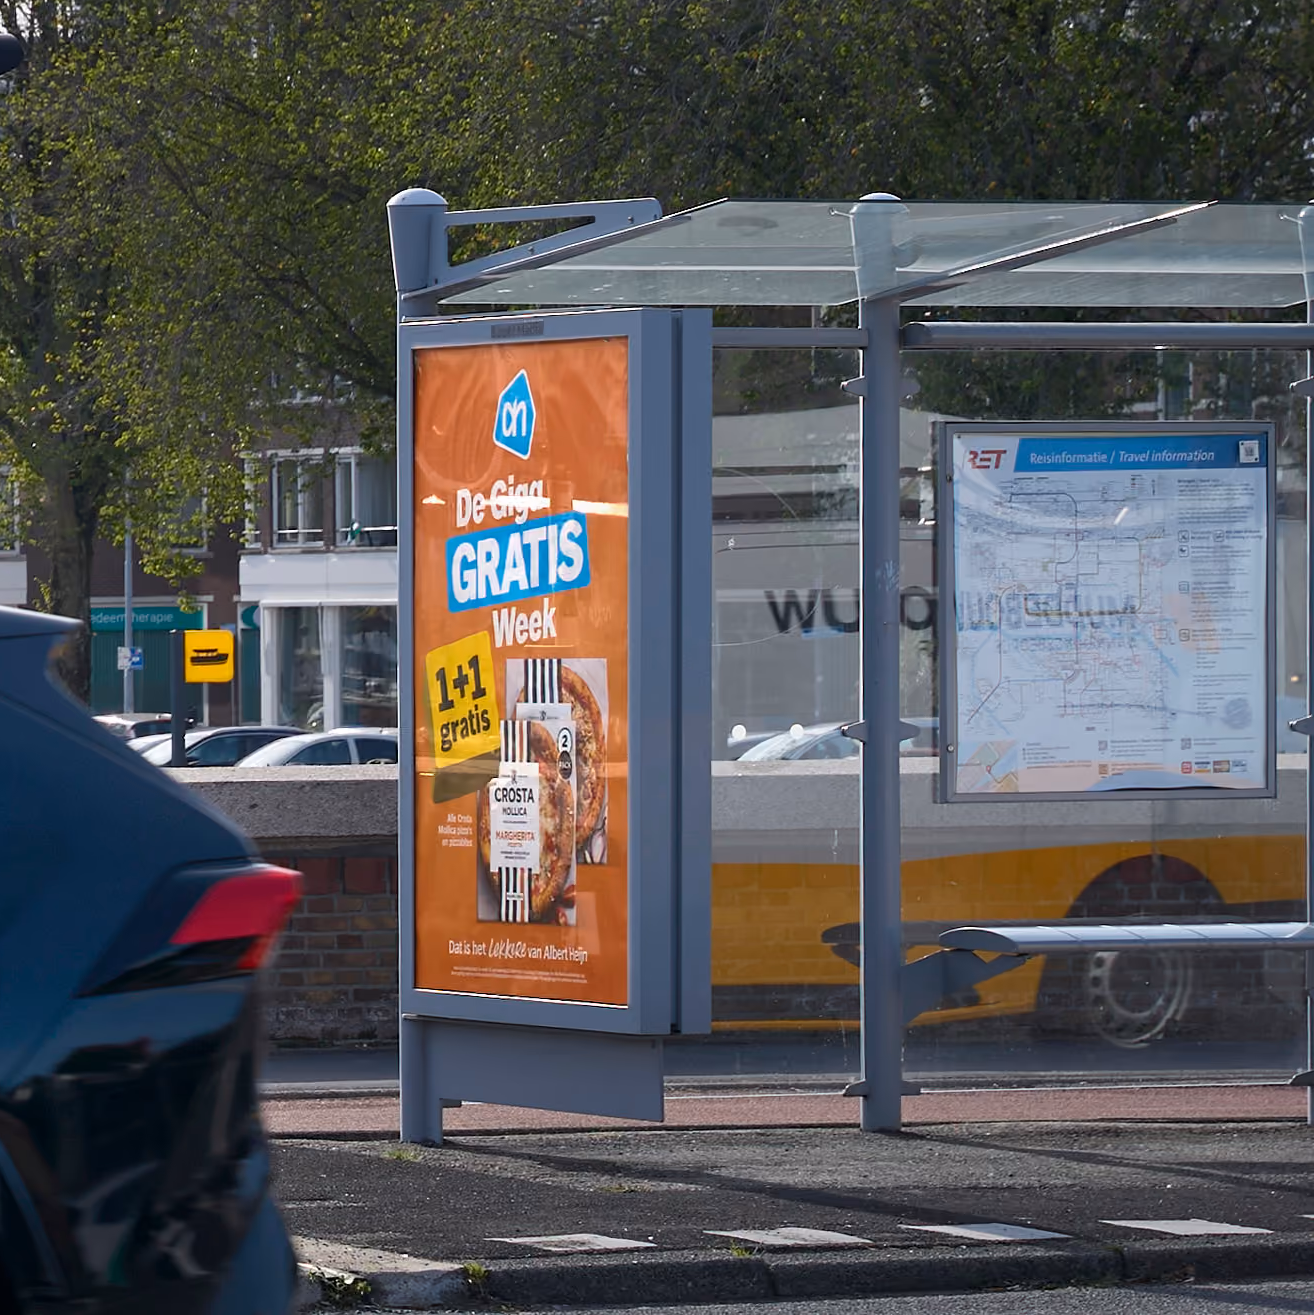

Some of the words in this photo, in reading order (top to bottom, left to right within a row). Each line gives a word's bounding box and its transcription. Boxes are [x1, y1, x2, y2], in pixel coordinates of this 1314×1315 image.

[967, 449, 1007, 470] RET
[1029, 451, 1108, 465] Reisinformatie
[1120, 450, 1149, 463] Travel
[1152, 449, 1215, 462] information
[456, 488, 486, 527] De
[490, 475, 544, 524] Giga
[452, 519, 584, 603] GRATIS
[492, 598, 557, 648] Week
[435, 655, 487, 712] 1+1
[440, 704, 491, 753] gratis
[561, 734, 568, 748] 2
[494, 787, 535, 804] CROSTA
[502, 806, 528, 817] MOLLICA
[448, 940, 463, 955] Dat
[463, 940, 471, 956] is
[472, 941, 487, 956] het
[527, 947, 542, 960] van
[543, 945, 569, 962] Albert
[569, 946, 588, 965] Heijn
